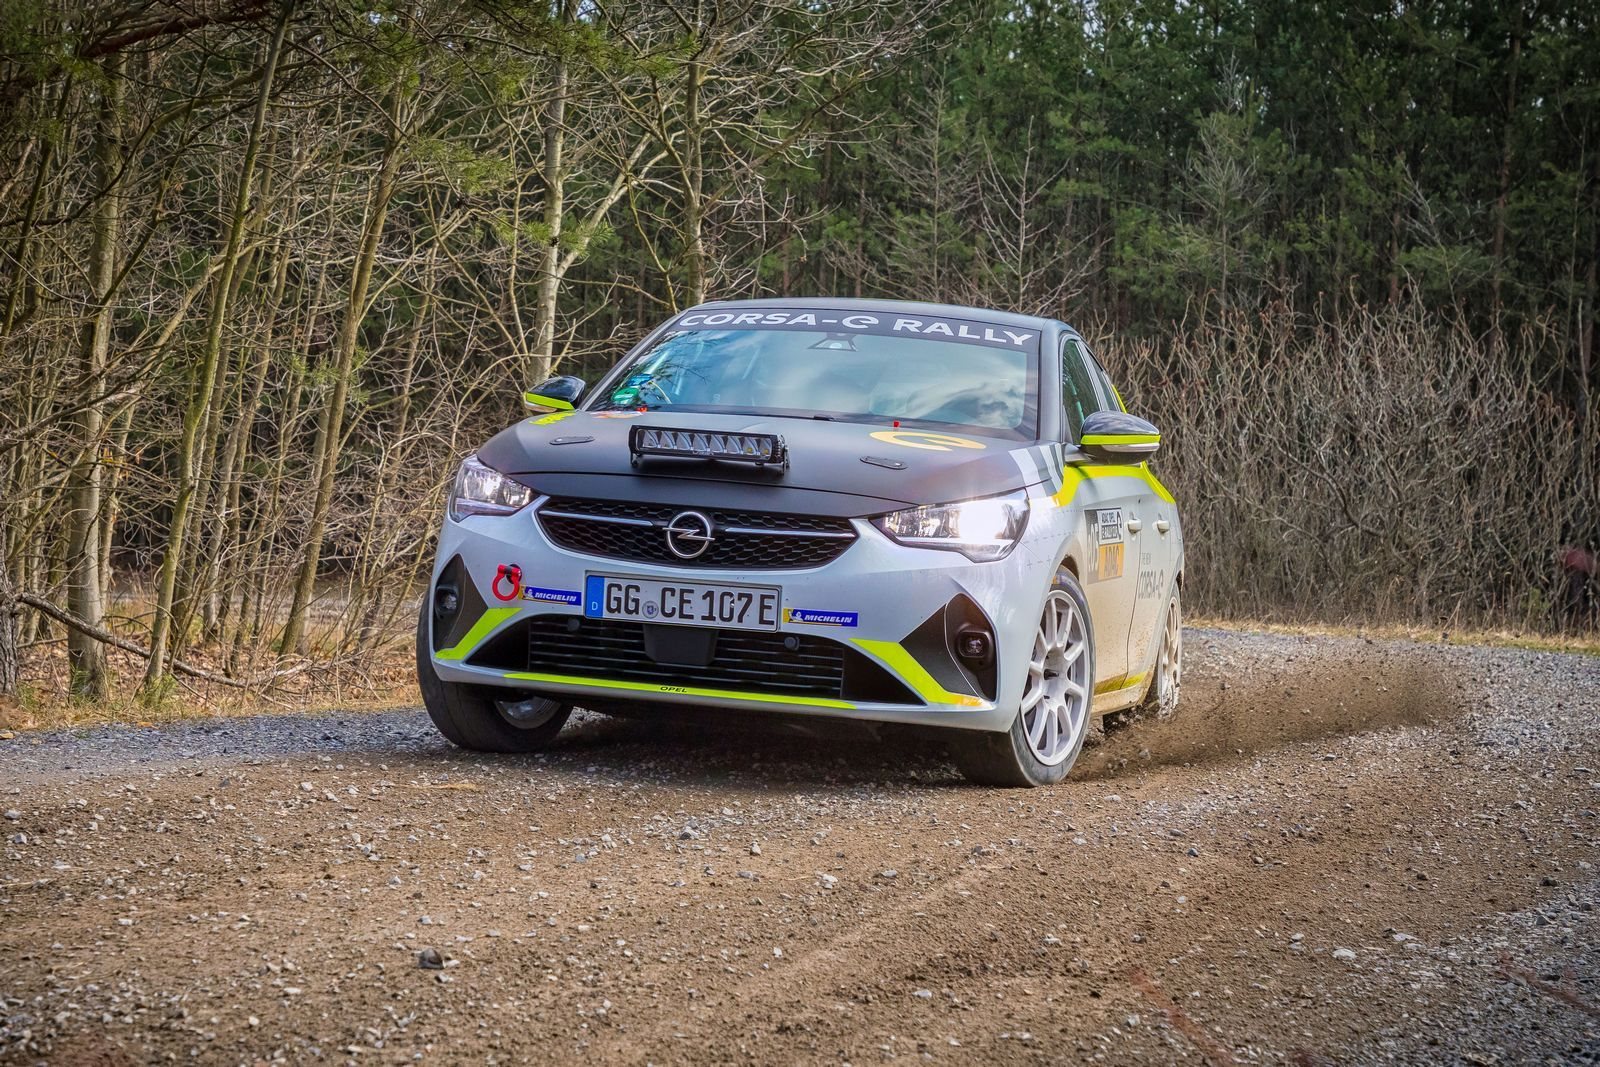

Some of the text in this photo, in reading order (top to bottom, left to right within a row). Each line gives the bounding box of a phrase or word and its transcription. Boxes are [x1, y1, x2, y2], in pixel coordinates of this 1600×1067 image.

[893, 318, 1033, 346] RALLY
[534, 591, 577, 602] MICHELIN
[606, 583, 641, 615] GG
[660, 587, 695, 620] CE
[591, 601, 599, 611] D
[804, 614, 853, 623] MICHELIN
